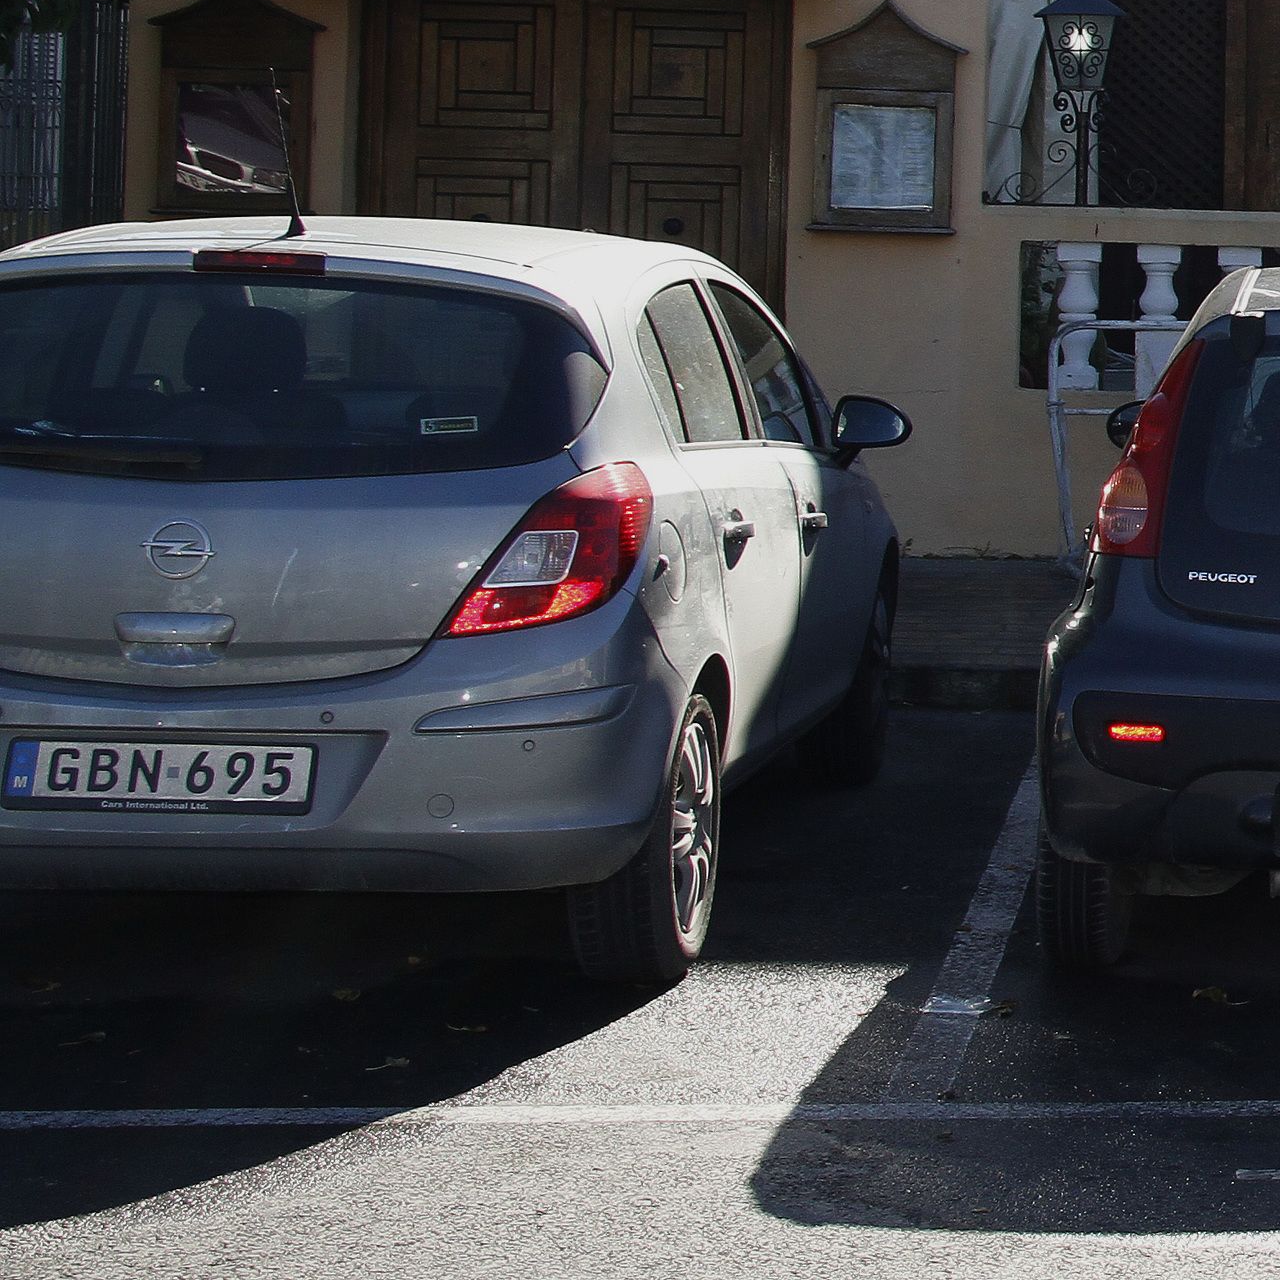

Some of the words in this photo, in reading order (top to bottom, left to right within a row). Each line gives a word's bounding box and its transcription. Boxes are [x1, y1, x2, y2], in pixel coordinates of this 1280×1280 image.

[1188, 570, 1258, 586] PEUGEOT
[47, 747, 164, 794] GBN
[185, 750, 295, 796] 695
[14, 775, 28, 789] M
[101, 800, 123, 808] Cars
[126, 801, 188, 810] International
[190, 802, 209, 810] Ltd.
